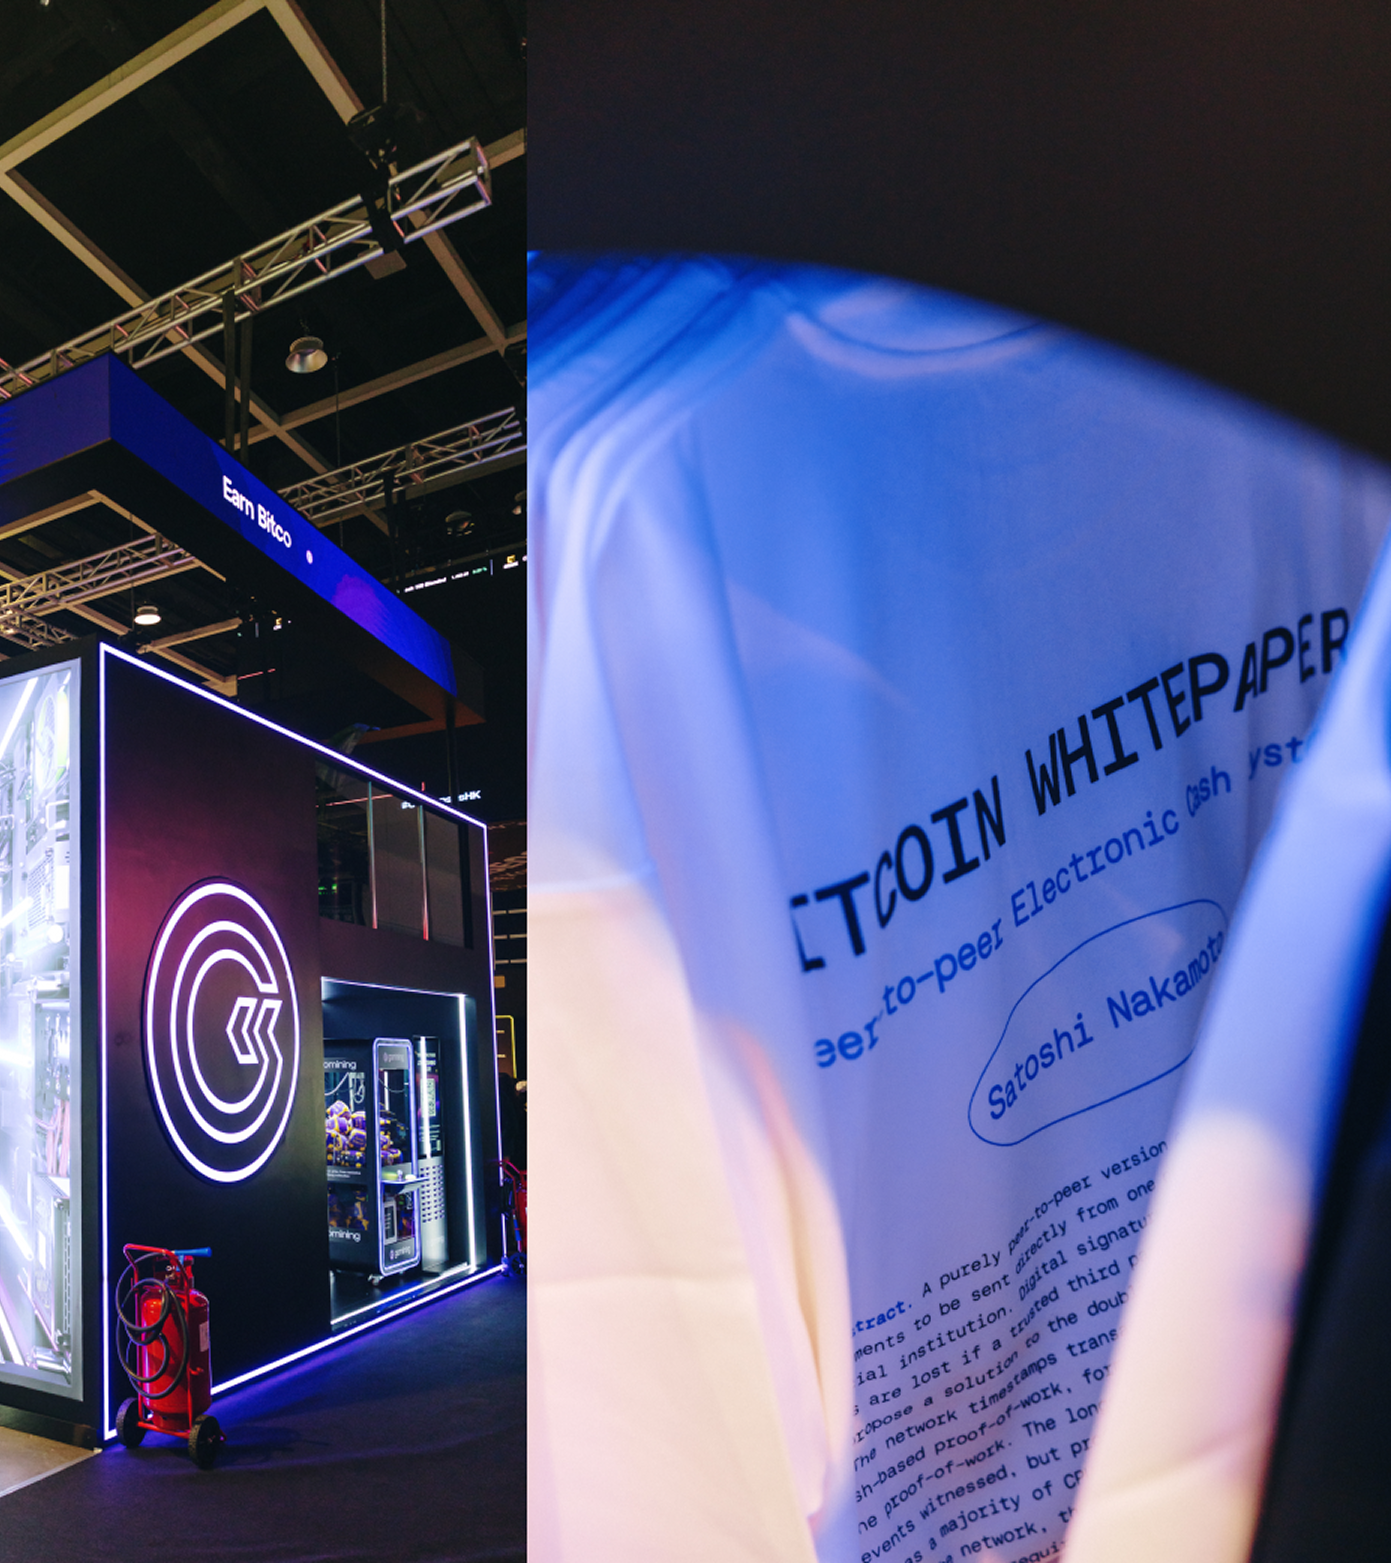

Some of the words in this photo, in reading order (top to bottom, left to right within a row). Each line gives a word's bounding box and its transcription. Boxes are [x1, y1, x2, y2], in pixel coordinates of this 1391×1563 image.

[223, 475, 255, 520] Earn
[258, 503, 292, 548] Bitco
[1025, 607, 1351, 816] WHITEPAPER
[1010, 808, 1181, 928] Electronic
[987, 1012, 1094, 1119] Satoshi
[1106, 928, 1225, 1029] Nakamoto
[913, 1313, 932, 1331] to
[939, 1298, 961, 1316] be
[971, 1274, 1010, 1301] sent
[1015, 1220, 1066, 1275] directly
[1076, 1197, 1119, 1223] from
[1127, 1179, 1156, 1201] one
[922, 1282, 932, 1298] A
[940, 1251, 1001, 1290] purely
[1008, 1175, 1092, 1256] peer-to-peer
[1101, 1140, 1168, 1180] version
[869, 1387, 902, 1406] are
[911, 1361, 952, 1389] lost
[962, 1344, 981, 1366] if
[992, 1338, 1002, 1351] a
[1010, 1286, 1060, 1338] trusted
[1067, 1259, 1121, 1293] third
[900, 1306, 1012, 1370] institution.
[1019, 1249, 1068, 1301] Digital
[924, 1396, 934, 1407] a
[945, 1351, 1019, 1398] solution
[1025, 1332, 1040, 1348] to
[1047, 1312, 1078, 1333] the
[885, 1409, 958, 1449] network
[968, 1353, 1058, 1414] timestamps
[934, 1382, 1072, 1456] proof-of-work,
[861, 1519, 916, 1563] events
[919, 1463, 1016, 1520] witnessed,
[1026, 1447, 1061, 1469] but
[884, 1440, 1012, 1519] proof-of-work.
[1021, 1417, 1056, 1437] The
[928, 1536, 937, 1551] a
[939, 1494, 1020, 1538] majority
[1032, 1480, 1052, 1501] of
[960, 1522, 1047, 1557] network,
